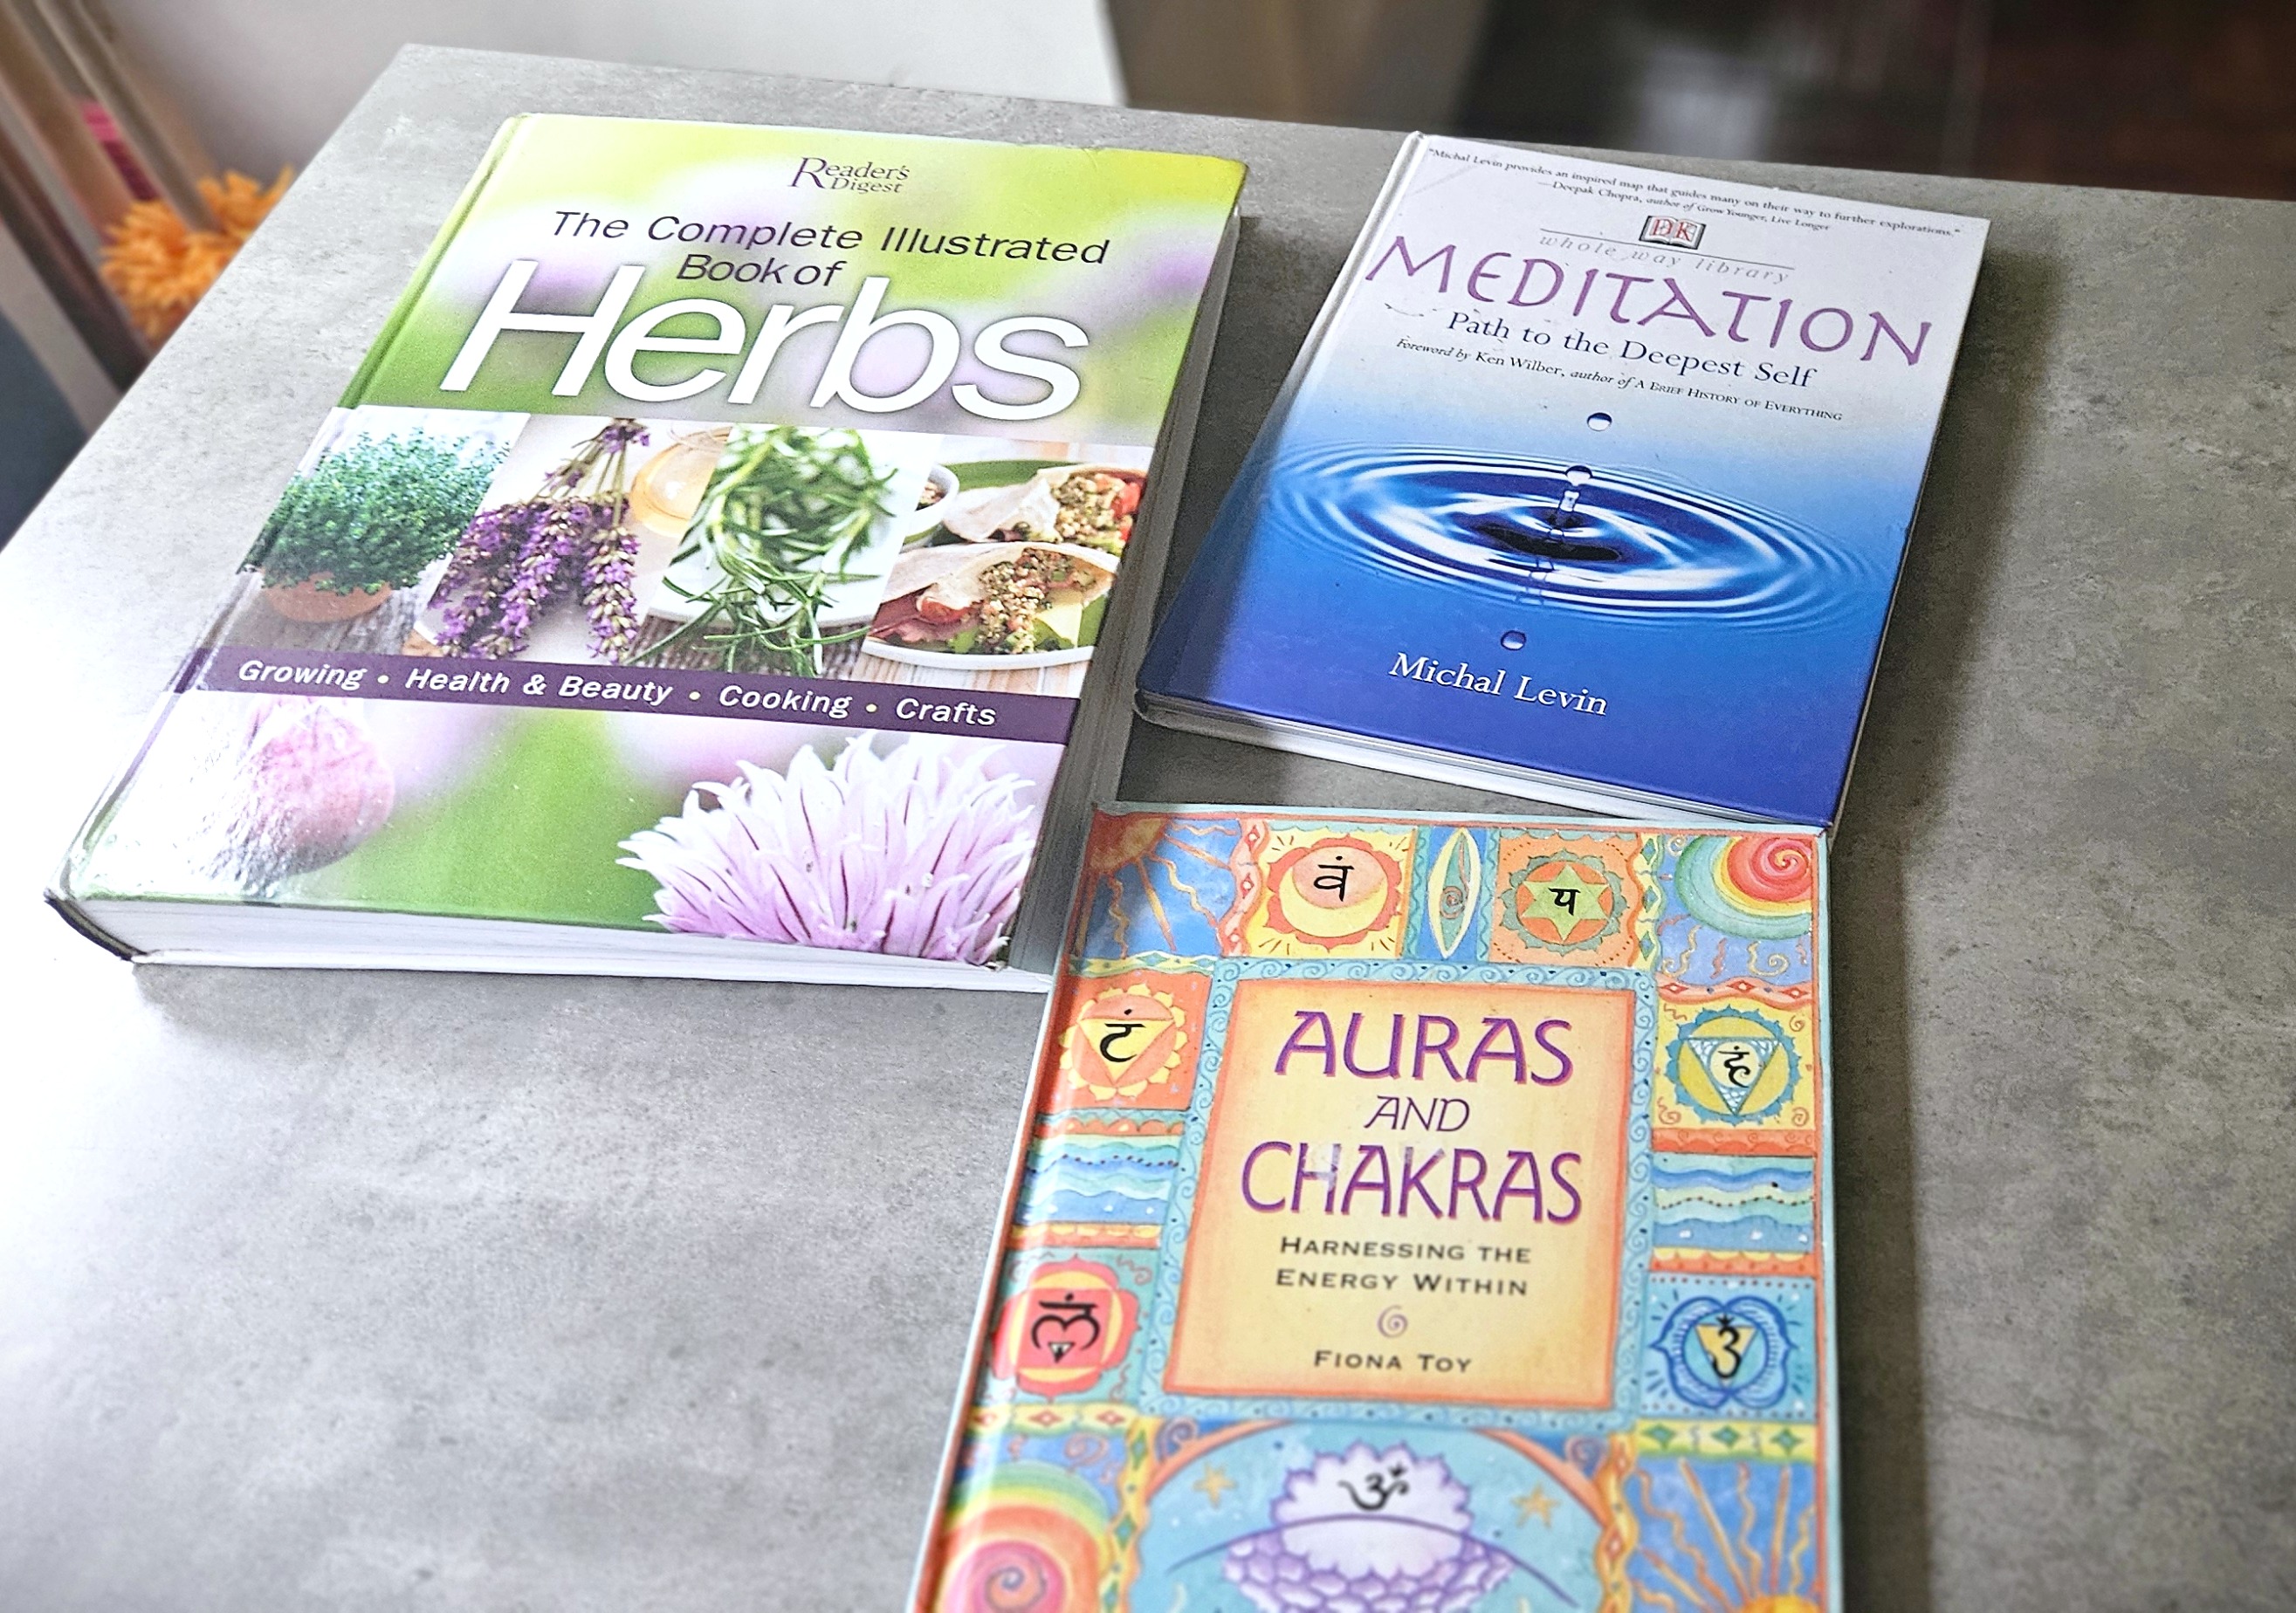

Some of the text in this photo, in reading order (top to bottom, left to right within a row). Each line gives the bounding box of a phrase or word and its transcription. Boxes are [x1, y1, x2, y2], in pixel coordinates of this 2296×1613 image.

[829, 177, 904, 195] Digest
[1473, 156, 1502, 168] Levin
[1505, 163, 1553, 175] provides
[1571, 173, 1618, 186] inspired
[1619, 181, 1645, 192] map
[1647, 184, 1668, 194] that
[1671, 189, 1708, 200] guides
[1709, 195, 1742, 207] many
[1763, 202, 1791, 213] their
[1793, 207, 1818, 218] way
[1819, 210, 1832, 219] to
[1834, 212, 1877, 225] further
[1598, 189, 1643, 203] Chopra,
[1646, 197, 1681, 209] author
[1682, 202, 1696, 212] of
[1697, 205, 1725, 215] Grow
[1770, 215, 1792, 225] Live
[1794, 219, 1831, 231] Longer
[552, 211, 1110, 264] The Complete Illustrated
[1649, 218, 1698, 243] DK
[676, 253, 848, 287] Book of
[1539, 235, 1789, 285] whole way library
[1365, 235, 1933, 367] MEDITATION
[439, 258, 1090, 422] Herbs
[1396, 338, 1455, 358] Foreword
[1455, 348, 1472, 362] by
[1475, 351, 1506, 367] Ken
[1509, 355, 1567, 378] Wilber,
[1570, 370, 1615, 385] author
[1617, 376, 1638, 390] of
[1634, 380, 1646, 389] A
[1447, 311, 1818, 388] Path to the Deepest Self
[237, 660, 998, 726] Growing Health & Beauty Cooking Crafts
[1388, 651, 1609, 717] Michal Levin
[1274, 1010, 1574, 1087] AURAS
[1364, 1095, 1470, 1133] AND
[1241, 1141, 1583, 1225] CHAKRAS
[1280, 1236, 1532, 1264] HARNESSING THE
[1275, 1268, 1528, 1296] ENERGY WITHIN
[1313, 1349, 1472, 1375] FIONA TOY
